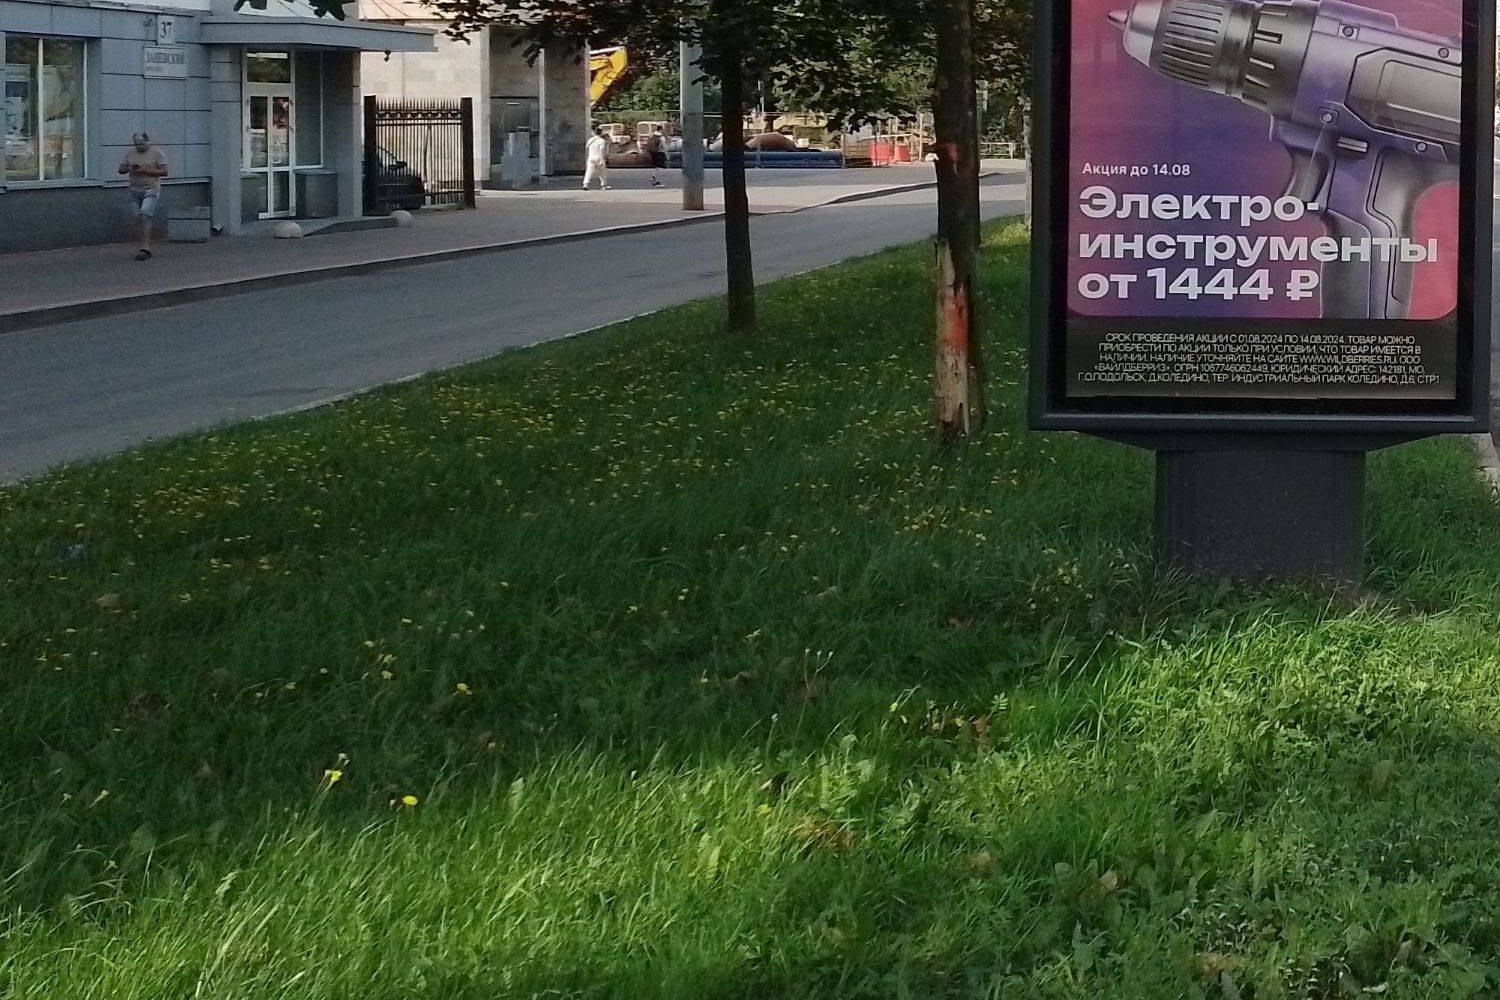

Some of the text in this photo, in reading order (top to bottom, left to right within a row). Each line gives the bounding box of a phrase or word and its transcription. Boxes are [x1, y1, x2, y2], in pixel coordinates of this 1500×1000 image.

[1082, 163, 1191, 178] Акция до 14.08
[1078, 185, 1320, 227] Электро-
[1078, 233, 1438, 267] инструменты
[1077, 272, 1138, 299] от
[1146, 268, 1273, 301] 1444
[1105, 333, 1131, 342] СРОК
[1132, 334, 1194, 343] ПРОВЕДЕНИЯ
[1196, 334, 1228, 343] АКЦИИ
[1230, 334, 1237, 342] С
[1238, 334, 1282, 344] 01.08.2024
[1284, 335, 1298, 343] ПО
[1348, 336, 1376, 344] ТОВАР
[1378, 336, 1415, 344] МОЖНО
[1098, 343, 1161, 352] ПРИОБРЕСТИ
[1163, 344, 1176, 352] ПО
[1178, 344, 1210, 353] АКЦИИ
[1213, 344, 1249, 352] ТОЛЬКО
[1250, 344, 1270, 353] ПРИ
[1319, 346, 1338, 354] ЧТО
[1340, 346, 1369, 354] ТОВАР
[1370, 346, 1414, 354] ИМЕЕТСЯ
[1414, 346, 1421, 354] В
[1150, 354, 1196, 362] НАЛИЧИЕ
[1196, 353, 1252, 362] УТОЧНЯЙТЕ
[1253, 354, 1266, 362] НА
[1268, 354, 1298, 362] САЙТЕ
[1399, 356, 1421, 364] ООО
[1174, 364, 1198, 372] ОГРН
[1271, 364, 1344, 374] ЮРИДИЧЕСКИЙ
[1232, 373, 1320, 384] ИНДУСТРИАЛЬНЫЙ
[1322, 375, 1346, 383] ПАРК
